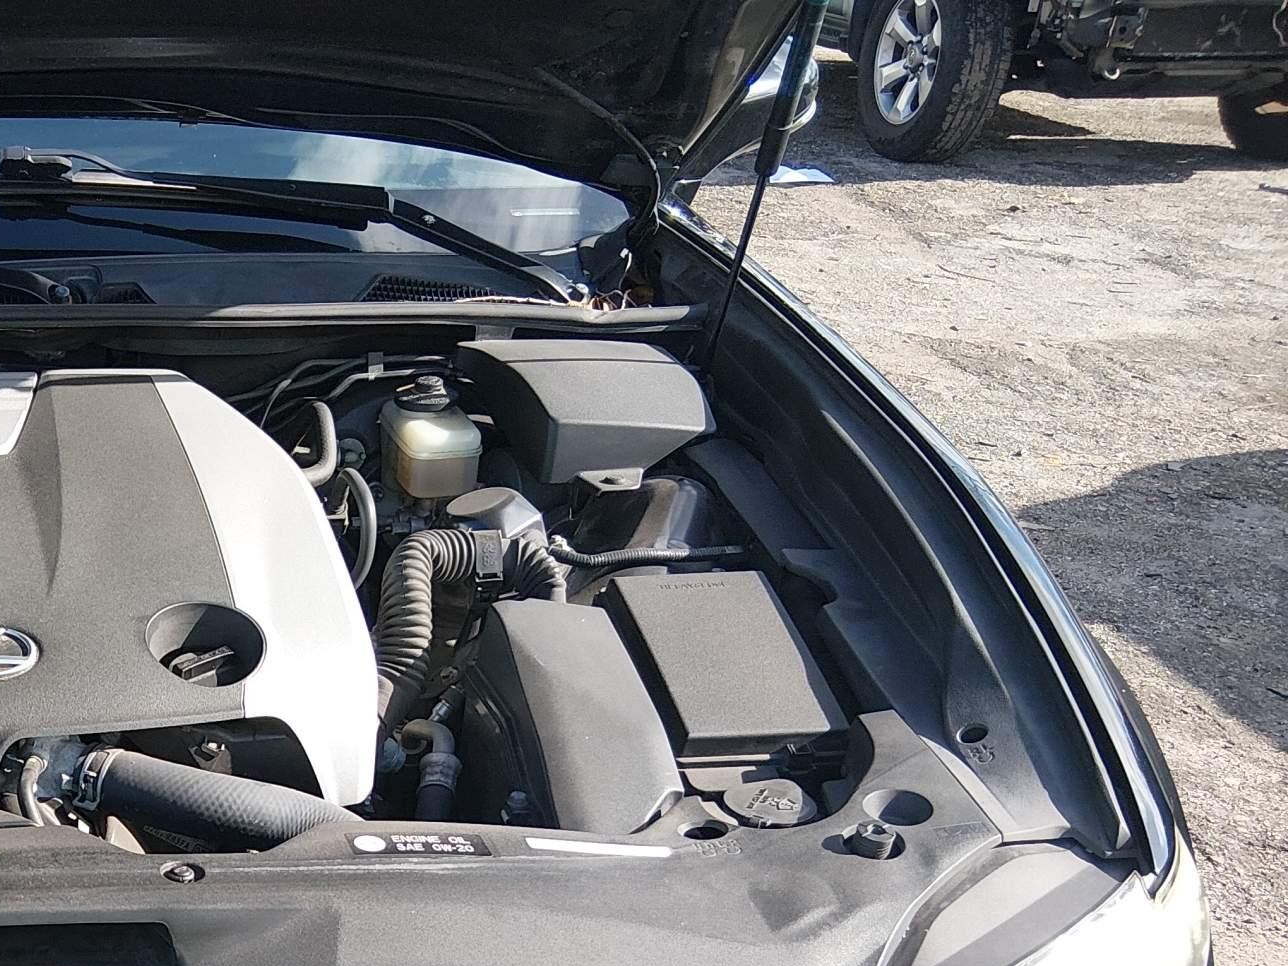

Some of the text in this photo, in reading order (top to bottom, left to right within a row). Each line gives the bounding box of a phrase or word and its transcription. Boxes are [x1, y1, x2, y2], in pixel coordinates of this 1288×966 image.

[391, 835, 471, 845] ENGINE OIL
[396, 843, 425, 851] SAE
